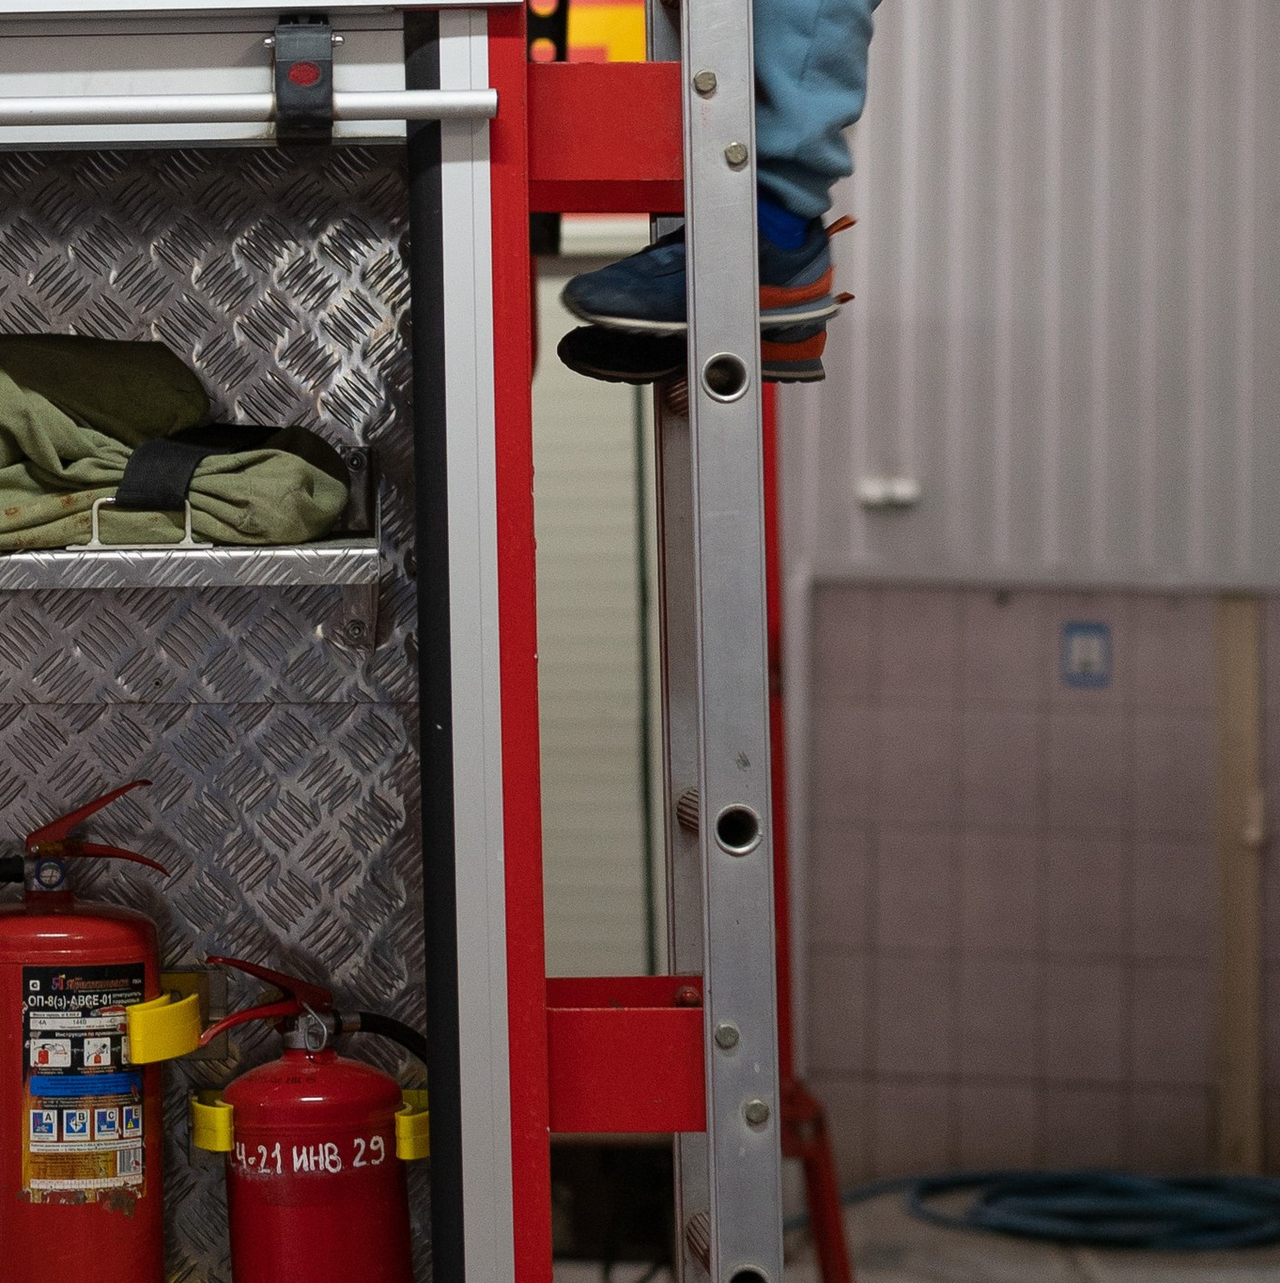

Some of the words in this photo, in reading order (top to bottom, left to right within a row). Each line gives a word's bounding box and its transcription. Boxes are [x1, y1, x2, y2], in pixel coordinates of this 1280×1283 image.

[45, 1113, 52, 1121] A
[78, 1112, 85, 1121] B
[108, 1111, 115, 1119] C
[292, 1142, 342, 1174] ИНВ
[353, 1135, 386, 1168] 29
